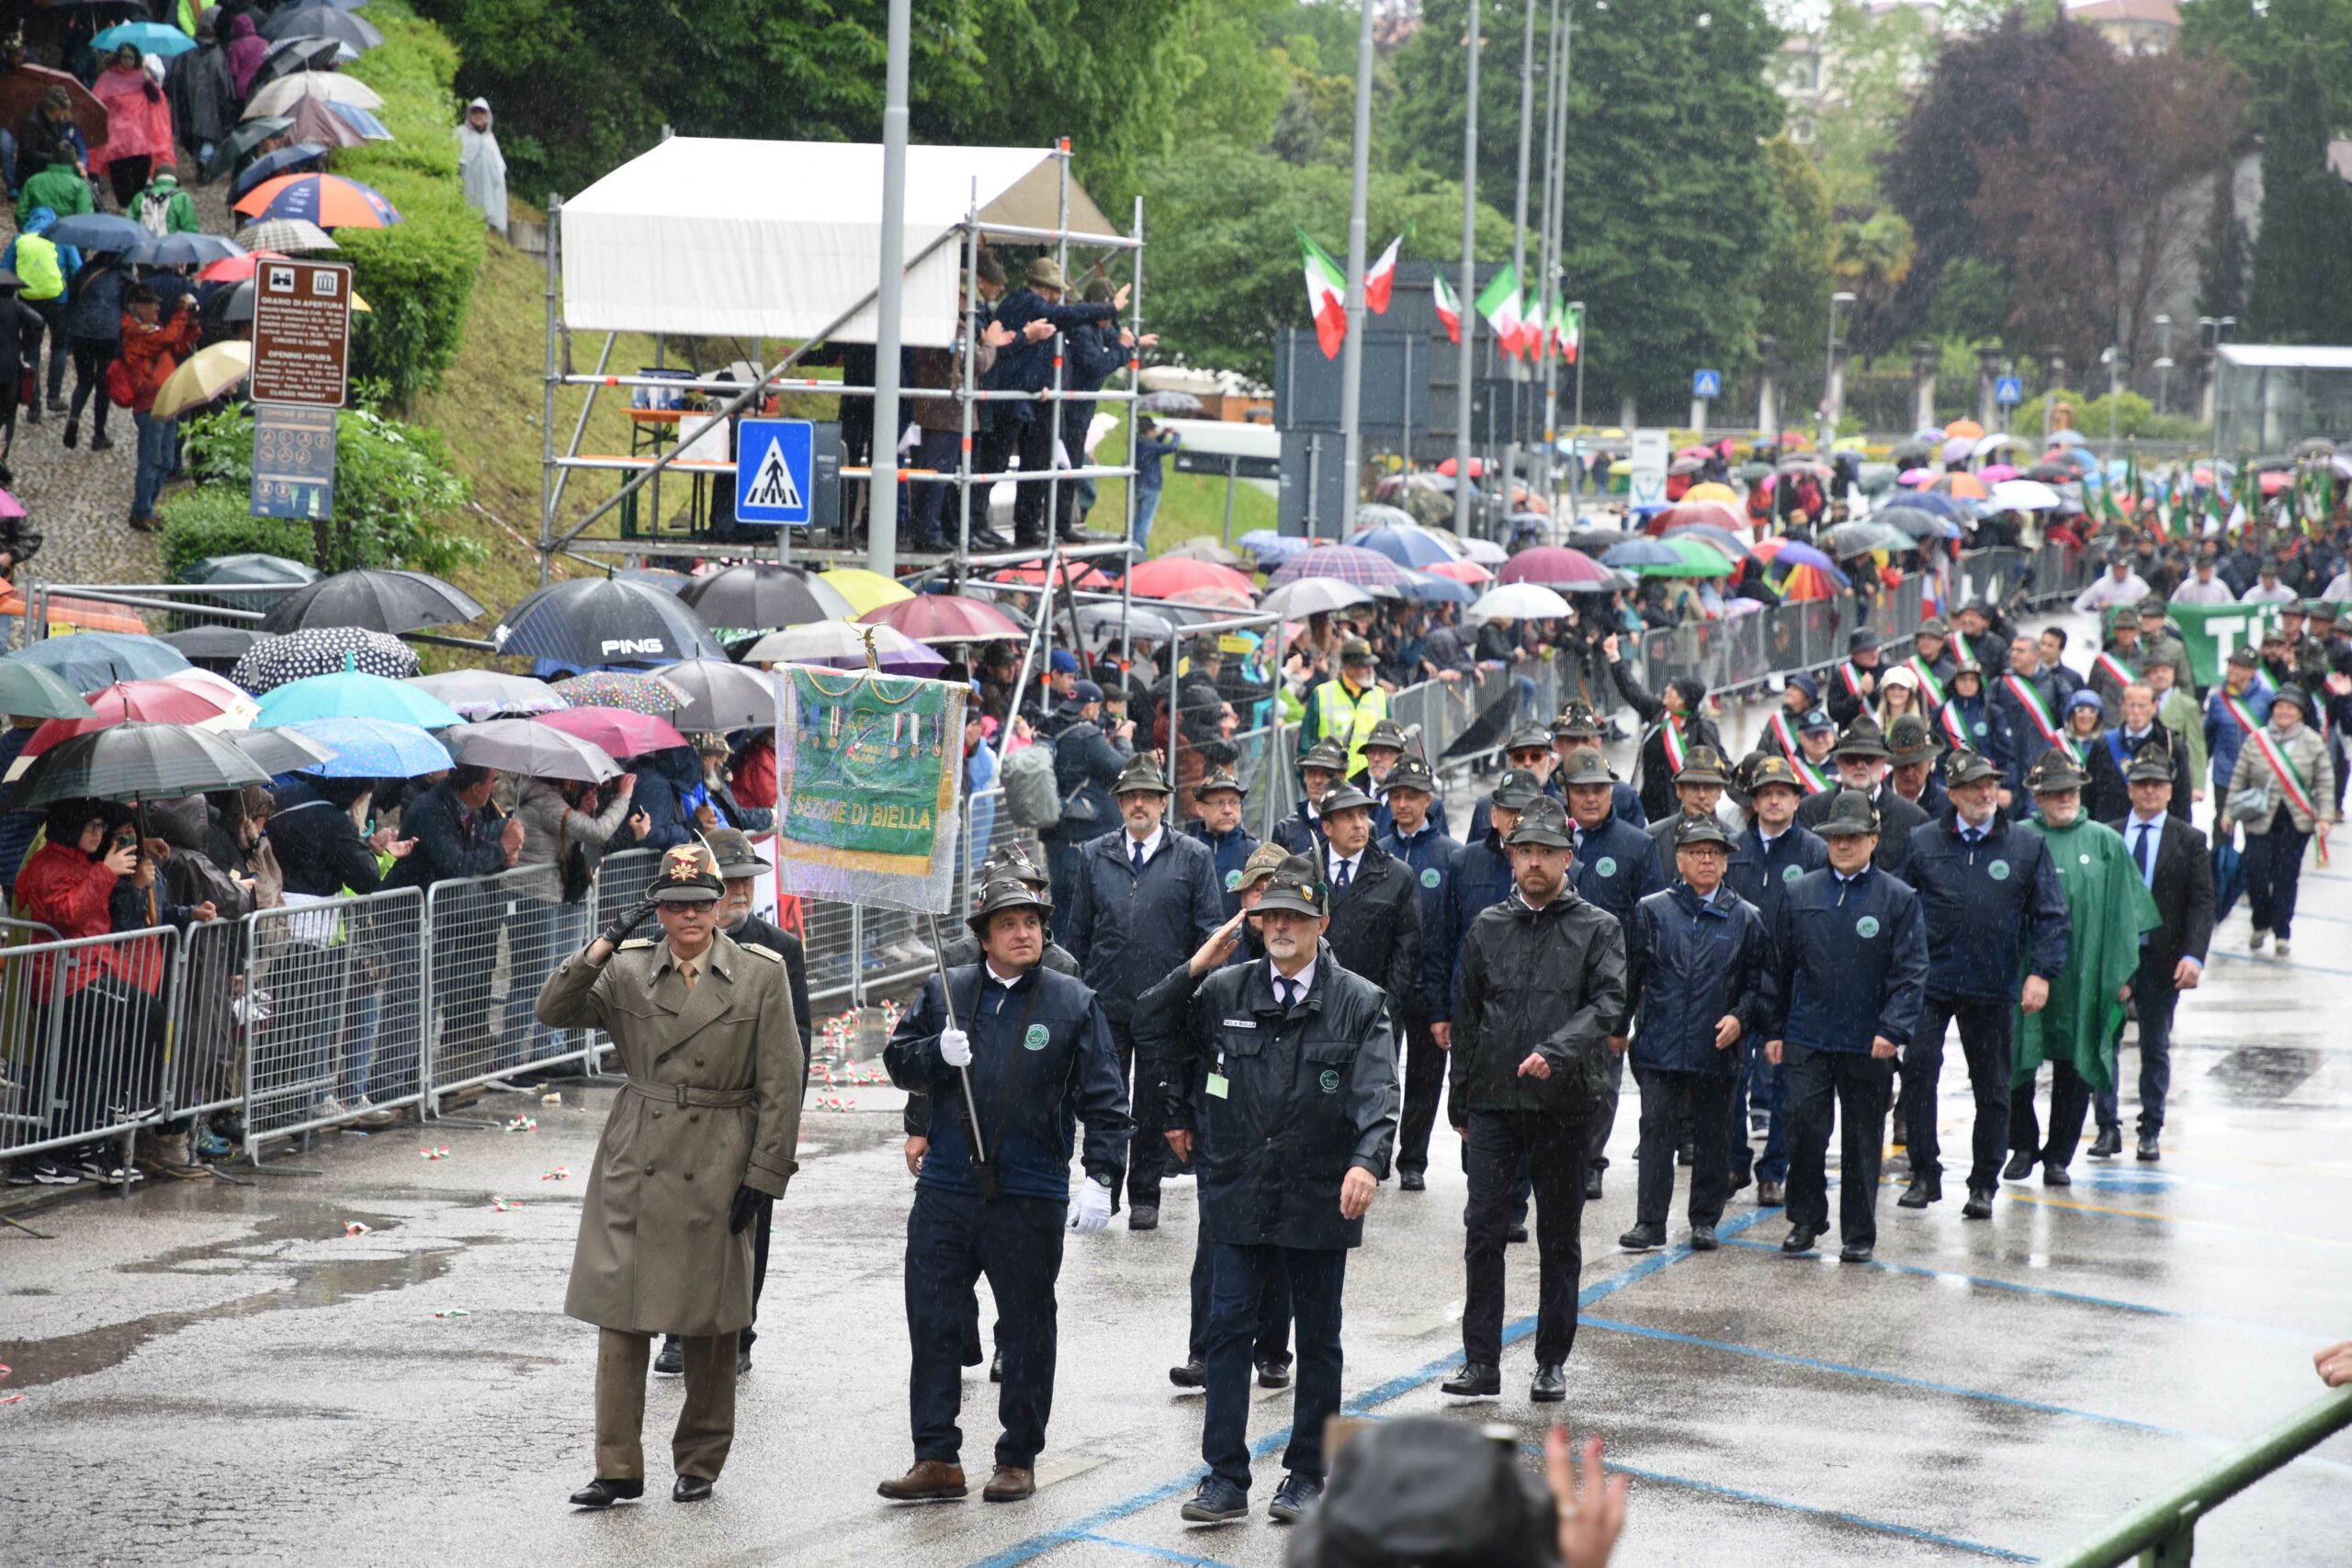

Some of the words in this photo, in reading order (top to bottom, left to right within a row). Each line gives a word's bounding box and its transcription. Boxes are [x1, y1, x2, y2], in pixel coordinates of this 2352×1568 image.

[293, 299, 301, 307] DI
[302, 299, 344, 310] APERTURA
[267, 350, 303, 360] OPENING
[304, 353, 332, 362] HOURS
[269, 389, 296, 397] CLOSED
[297, 391, 326, 400] MONDAY
[601, 637, 664, 656] PING
[793, 793, 847, 824] SEZIONE
[851, 802, 868, 825] DI
[870, 803, 931, 830] BIELLA
